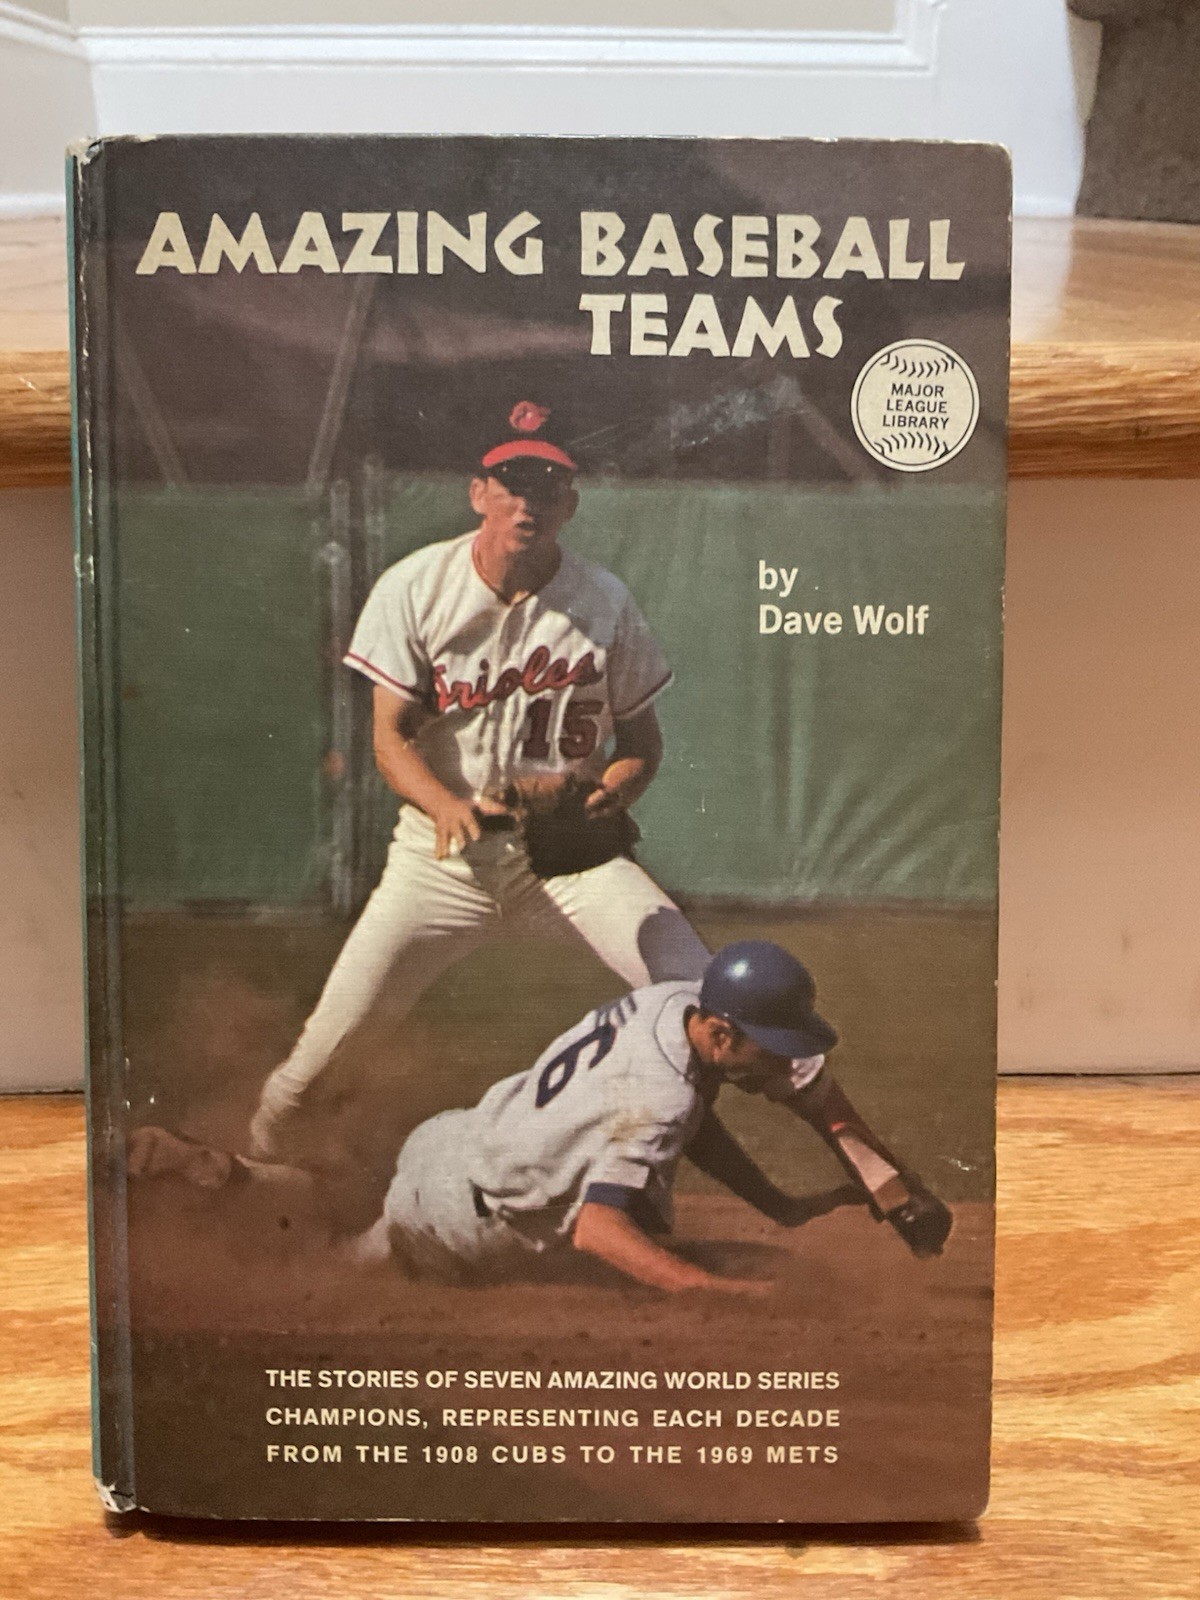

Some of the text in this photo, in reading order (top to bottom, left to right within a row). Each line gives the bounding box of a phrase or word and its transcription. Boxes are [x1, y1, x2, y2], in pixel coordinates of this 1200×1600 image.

[135, 211, 966, 280] AMAZING BASEBALL
[579, 293, 844, 358] TEAMS
[891, 383, 945, 397] MAJOR
[886, 399, 947, 413] LEAGUE
[882, 415, 949, 429] LIBRARY
[759, 559, 798, 597] by
[759, 604, 930, 635] Dave Wolf
[521, 699, 604, 757] 15
[265, 1369, 840, 1389] THE STORIES OF SEVEN AMAZING WORLD SERIES
[265, 1407, 840, 1429] CHAMPIONS, REPRESENTING EACH DECADE
[266, 1444, 839, 1464] FROM THE 1908 CUBS TO THE 1969 METS
